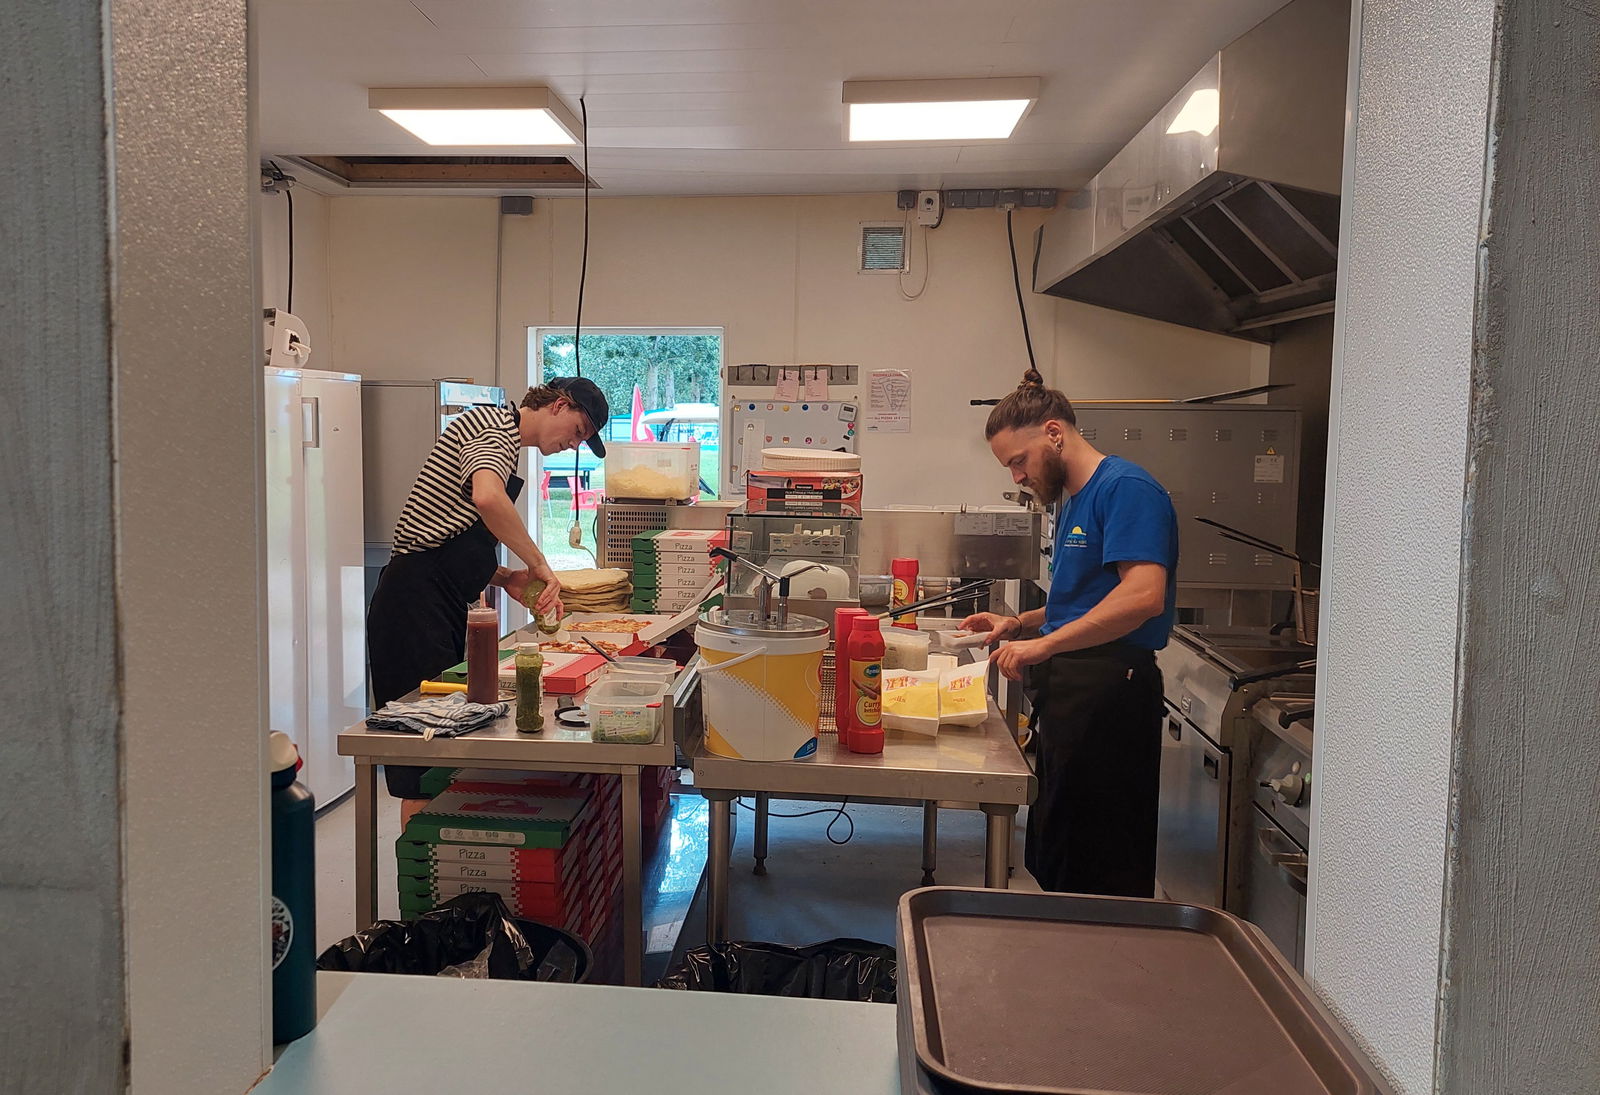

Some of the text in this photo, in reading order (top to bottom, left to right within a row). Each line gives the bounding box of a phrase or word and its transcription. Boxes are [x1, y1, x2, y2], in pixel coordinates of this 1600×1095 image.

[674, 542, 693, 550] Pizza
[677, 554, 695, 562] Pizza
[677, 566, 695, 574] Pizza
[677, 578, 695, 586] Pizza
[677, 590, 695, 598] Pizza
[672, 602, 686, 610] Pizz
[499, 680, 517, 688] izza
[459, 848, 486, 860] Pizza
[460, 866, 487, 877] Pizza
